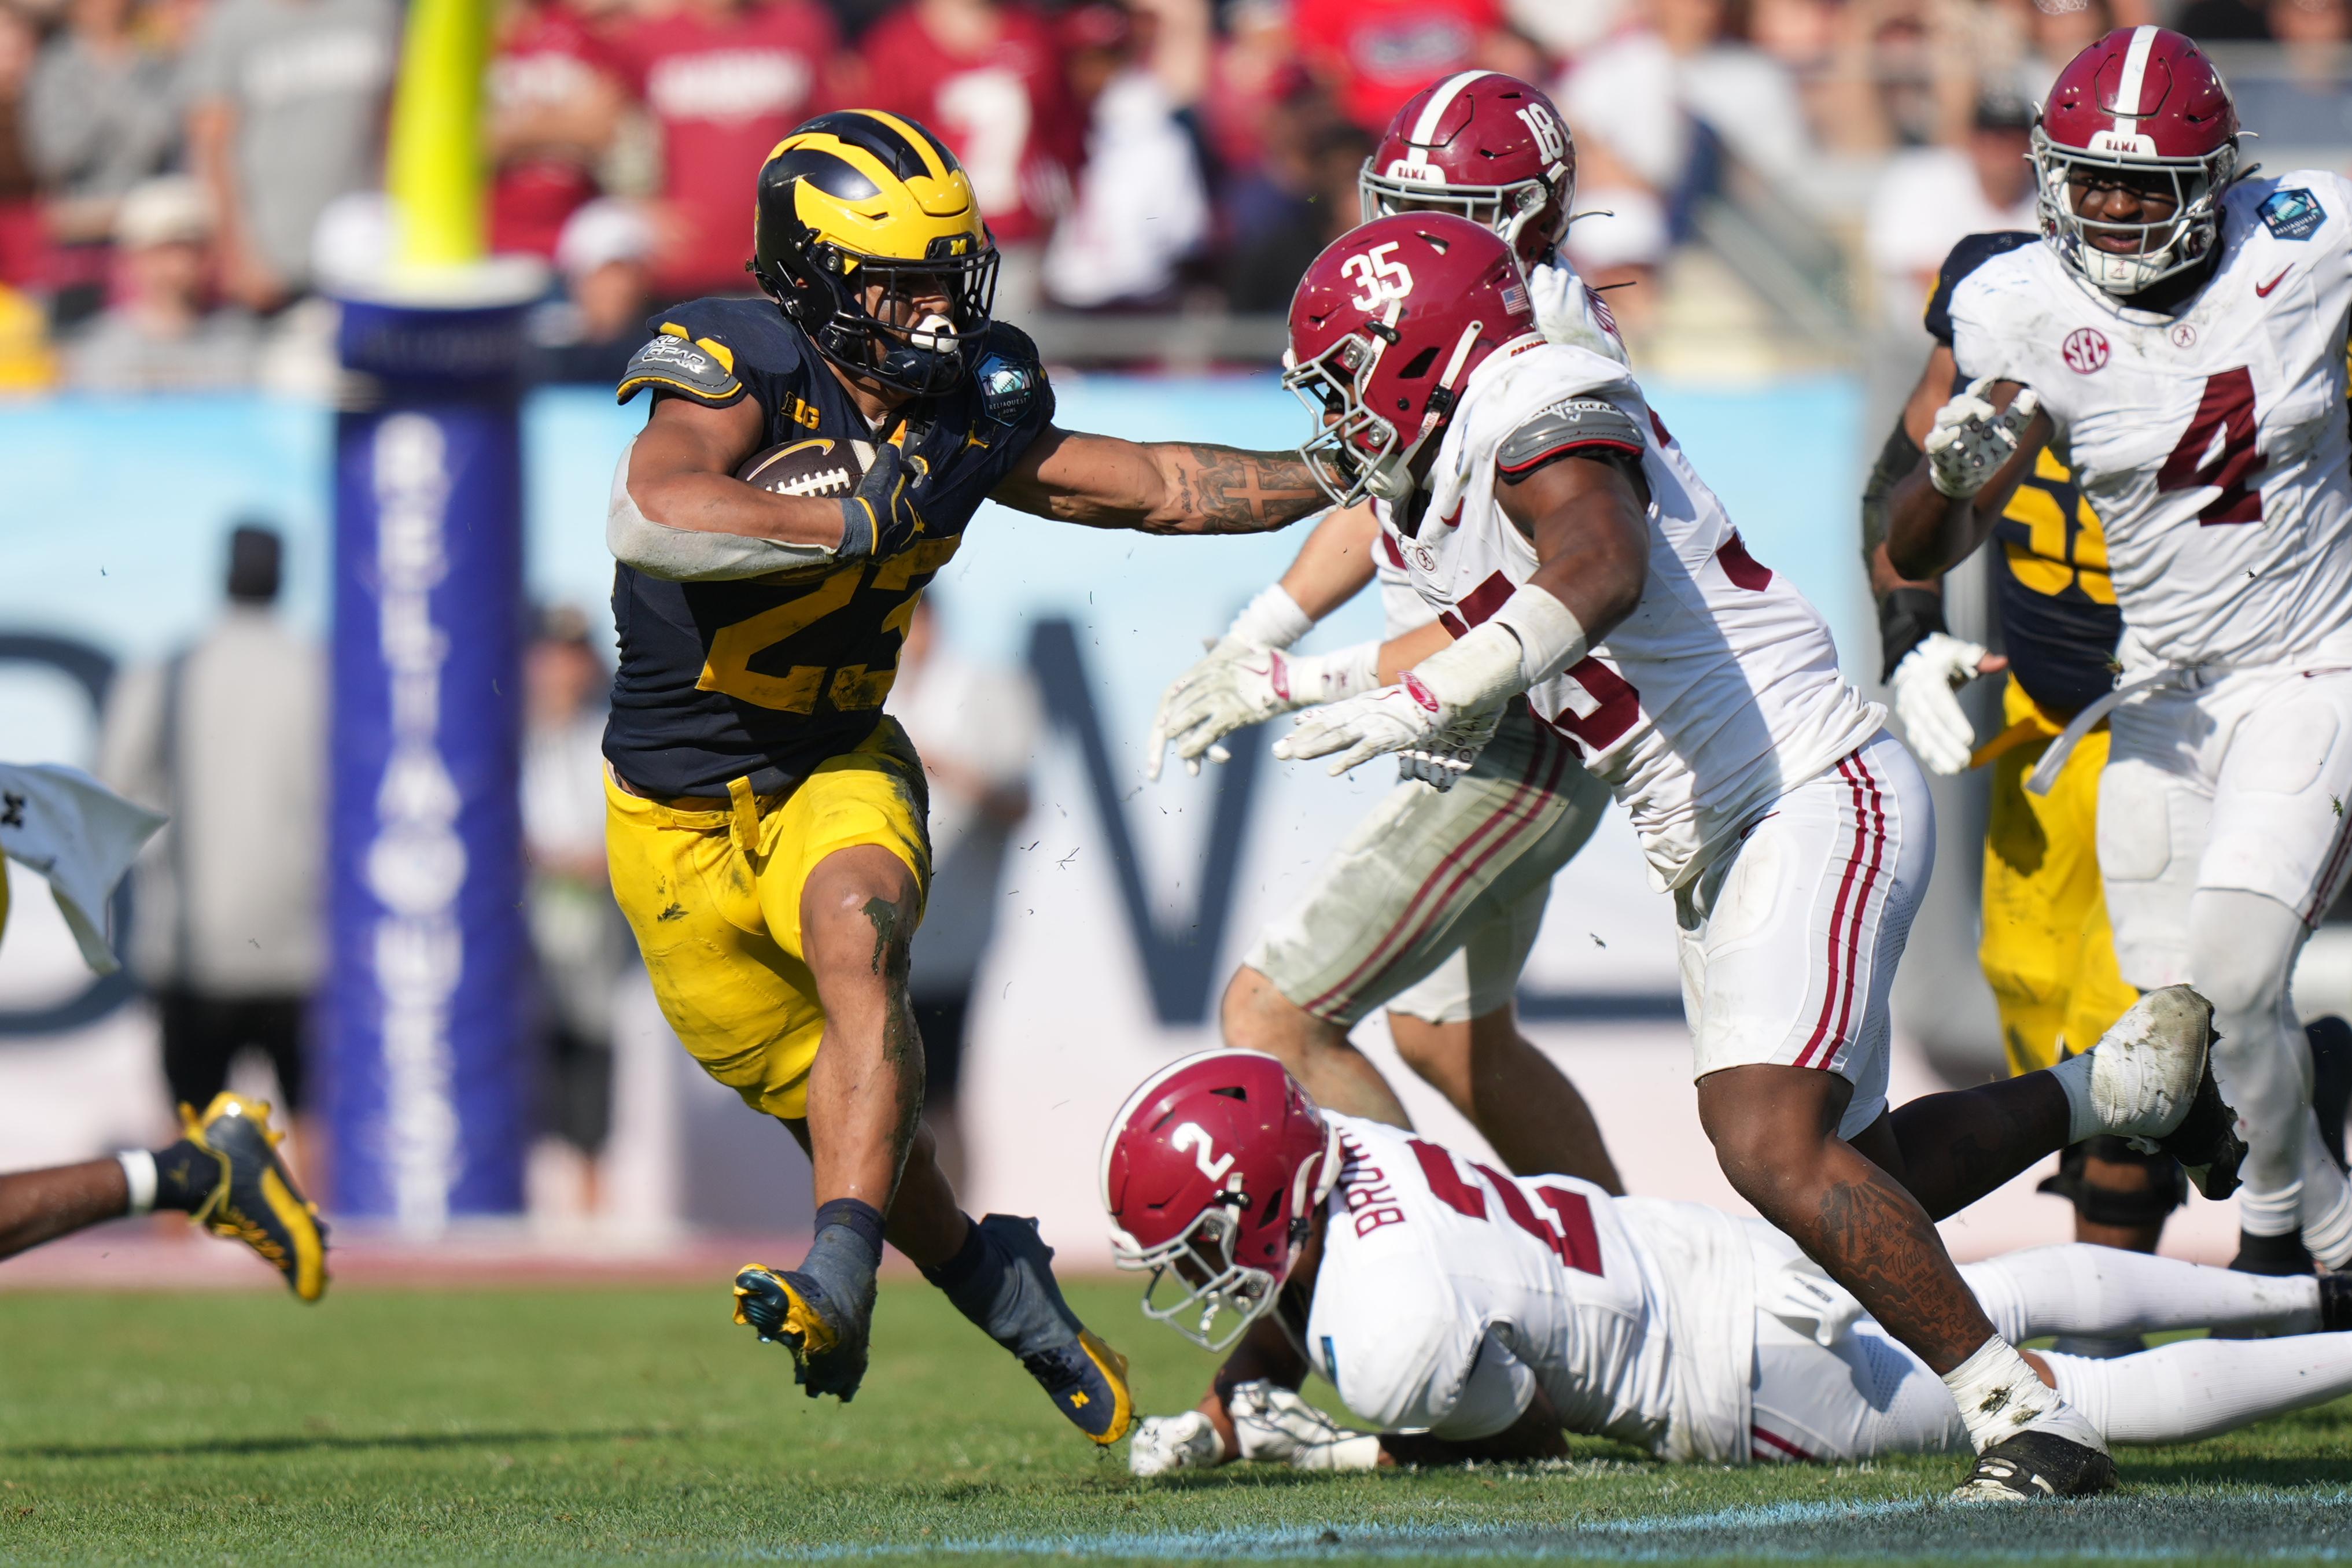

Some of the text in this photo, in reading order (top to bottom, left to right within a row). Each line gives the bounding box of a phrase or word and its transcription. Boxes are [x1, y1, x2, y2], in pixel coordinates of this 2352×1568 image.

[1516, 102, 1564, 165] 18
[2106, 139, 2139, 153] BAMA
[1398, 167, 1427, 180] BAMA
[950, 239, 967, 256] M
[1340, 241, 1413, 311] 35
[2064, 328, 2109, 373] SEC
[989, 397, 1027, 411] RELIAQUEST
[2157, 366, 2269, 526] 4
[695, 534, 961, 715] 23
[1172, 1122, 1234, 1182] 2
[1070, 1390, 1090, 1408] M
